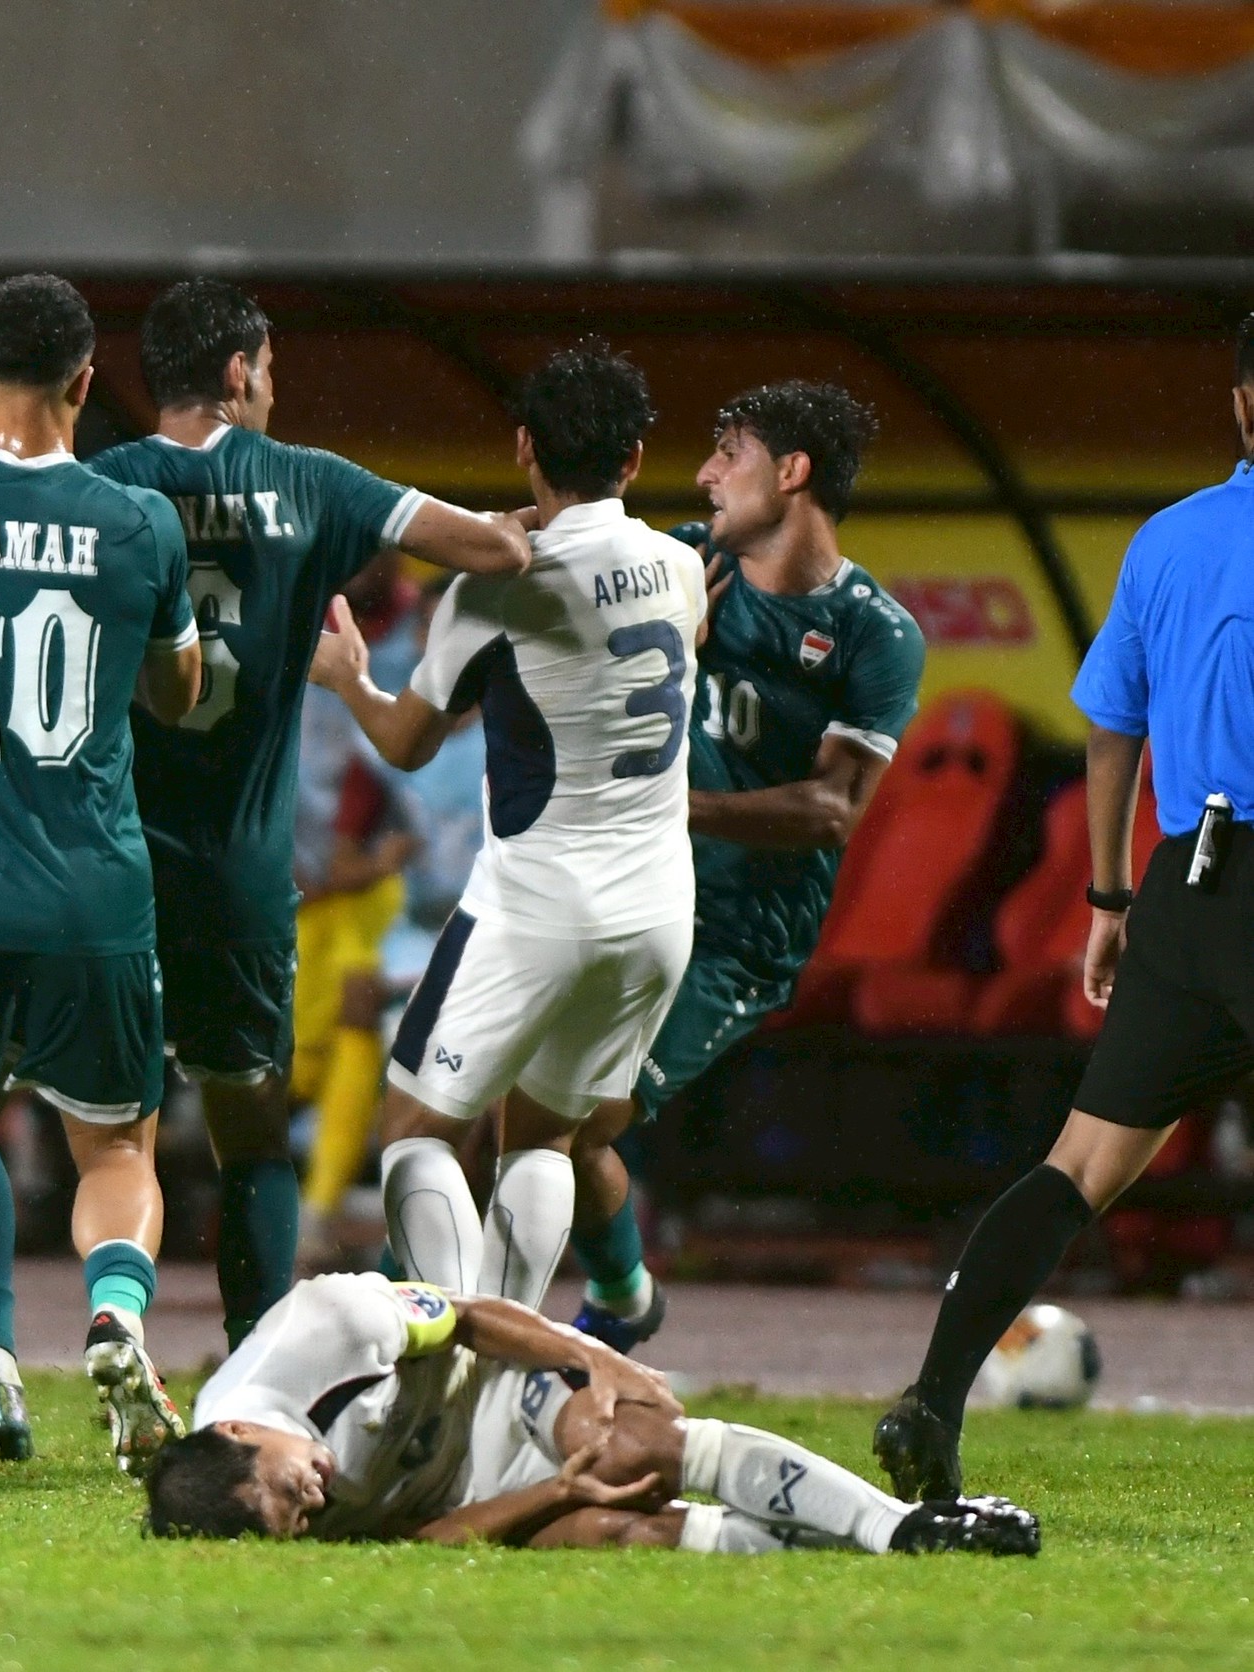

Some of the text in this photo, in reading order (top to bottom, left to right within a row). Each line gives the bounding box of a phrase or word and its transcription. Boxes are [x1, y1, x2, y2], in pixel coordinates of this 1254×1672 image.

[177, 492, 247, 541] NAF
[594, 560, 670, 608] APISIT
[607, 619, 687, 779] 3
[702, 672, 762, 747] 10
[642, 1057, 666, 1086] AKO
